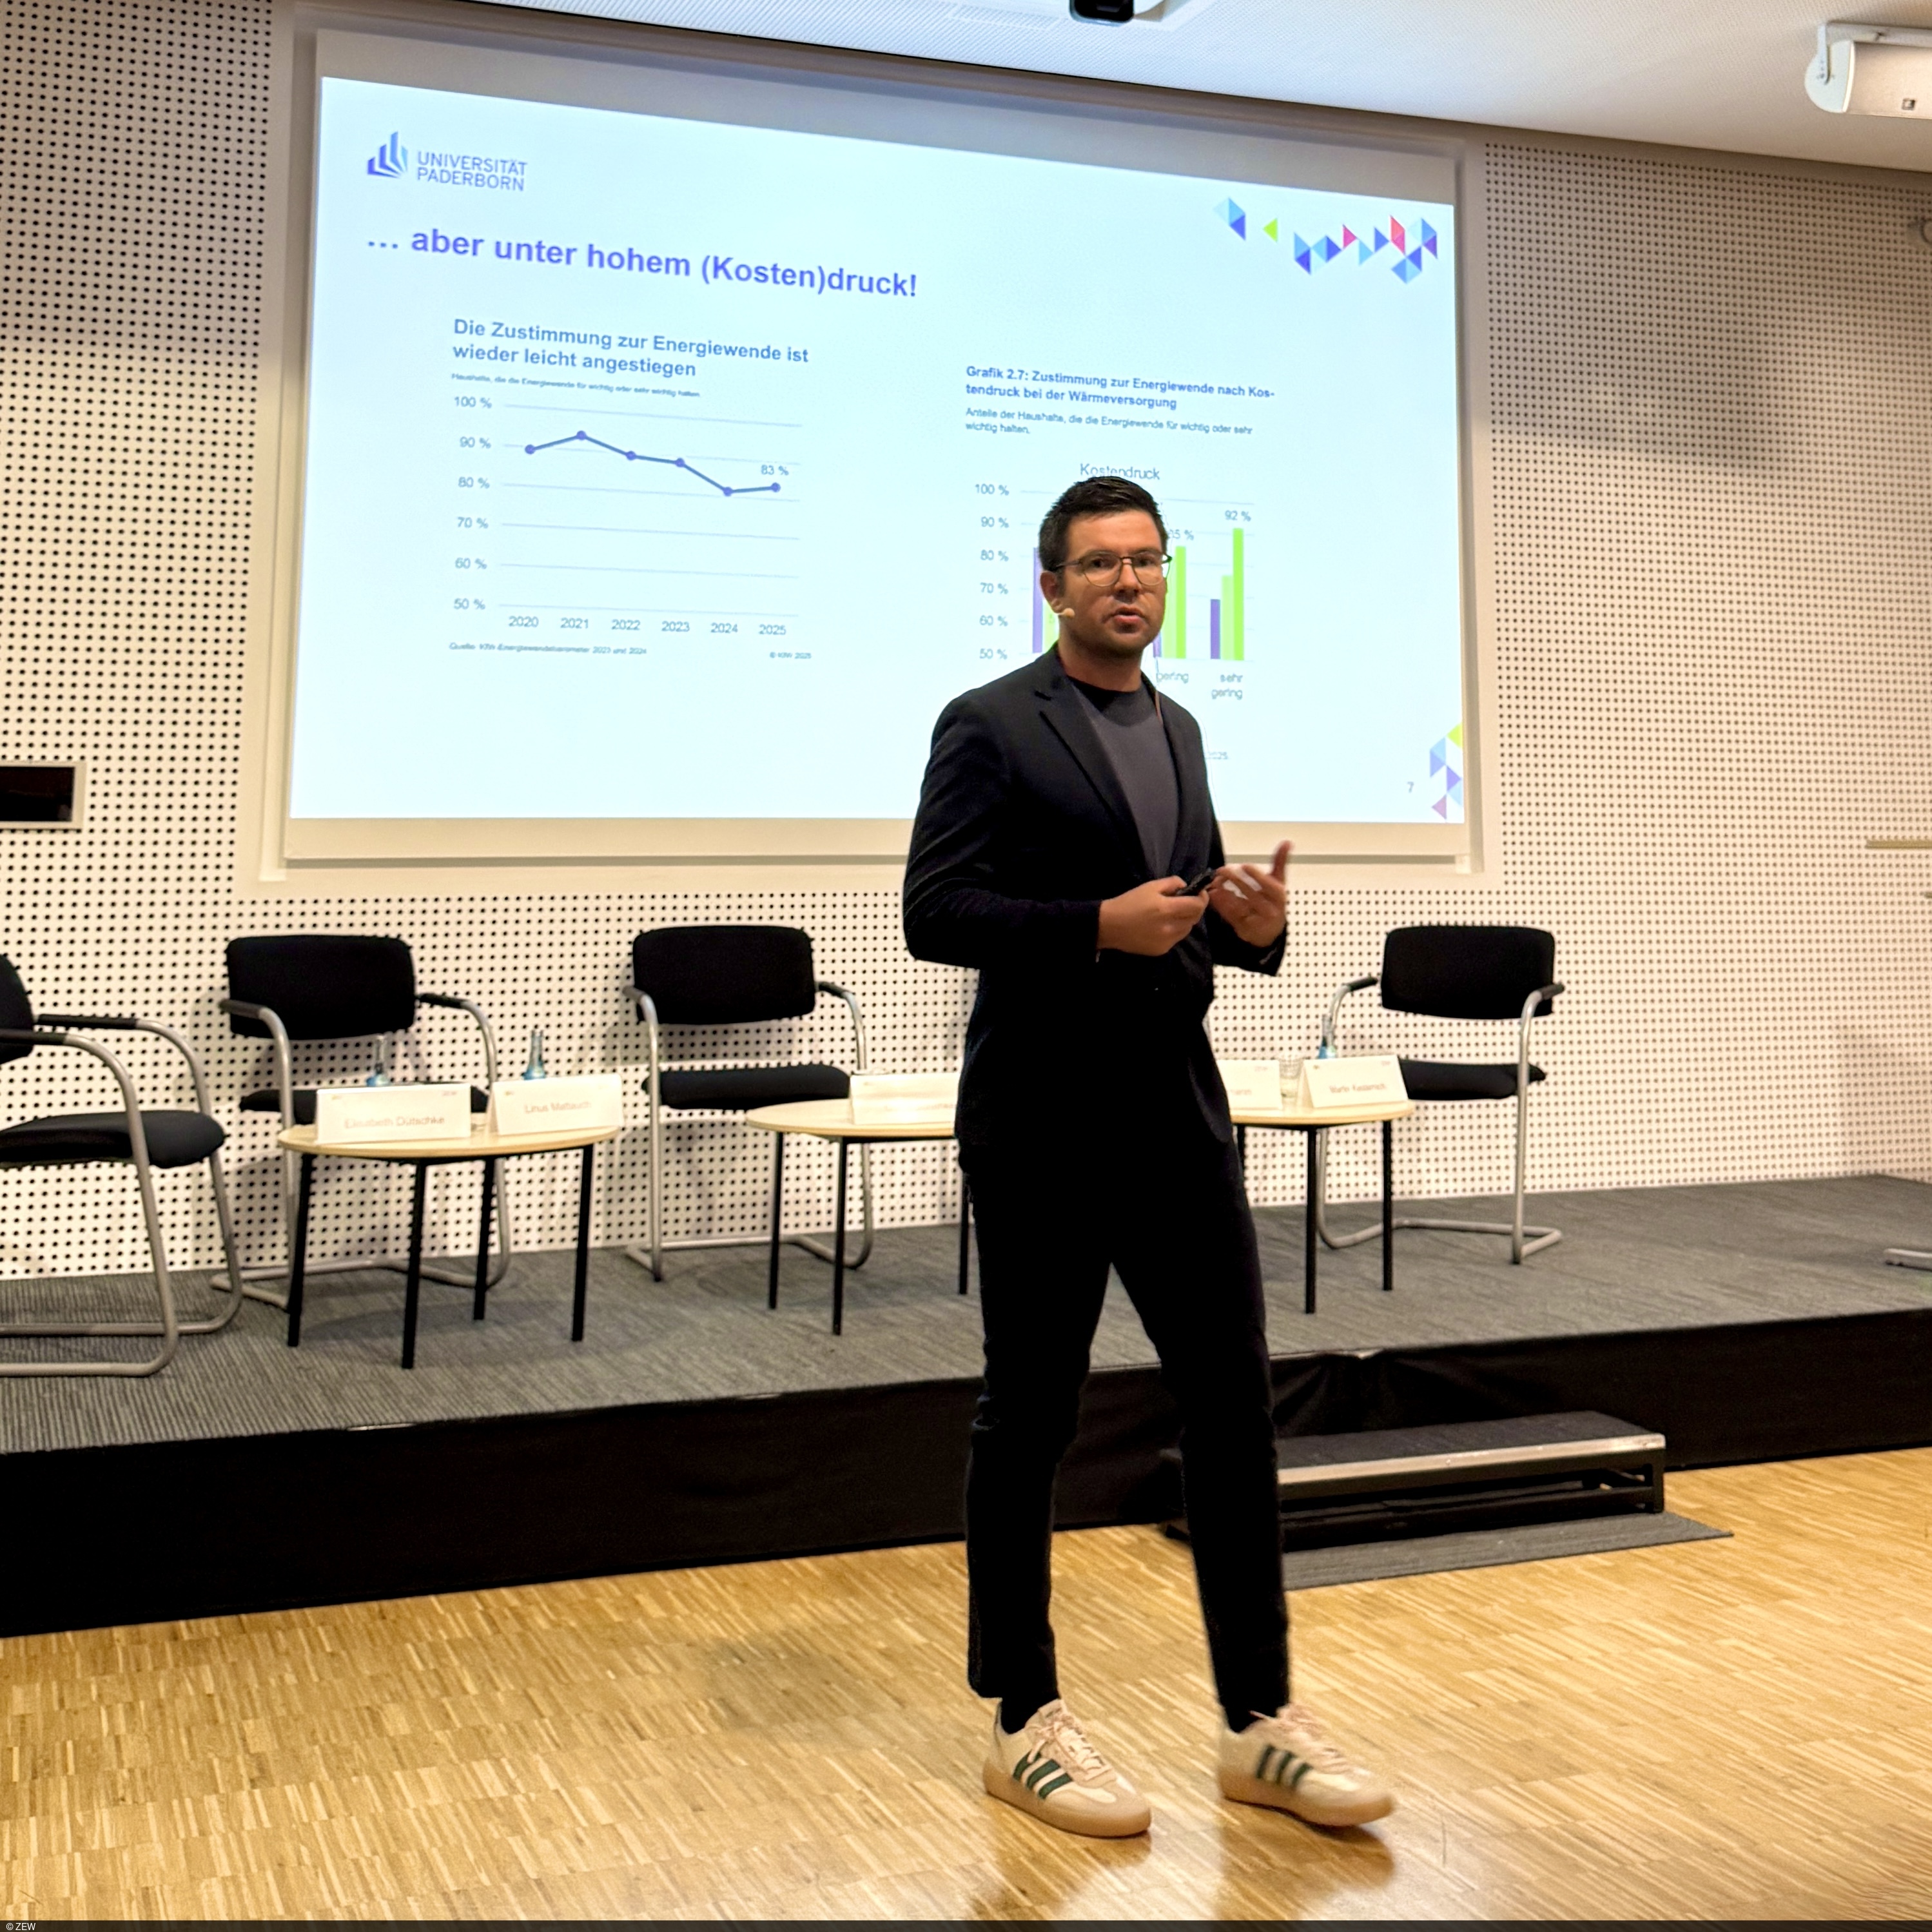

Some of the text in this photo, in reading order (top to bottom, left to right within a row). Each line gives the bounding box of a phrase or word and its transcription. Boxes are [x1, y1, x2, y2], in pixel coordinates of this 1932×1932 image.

[416, 150, 529, 177] UNIVERSITÄT
[416, 166, 525, 192] PADERBORN
[411, 228, 485, 257] aber
[494, 240, 578, 266] unter
[587, 244, 691, 277] hohem
[701, 255, 917, 297] (Kosten)druck!
[453, 318, 809, 363] Die Zustimmung zur Energiewende ist
[453, 343, 696, 378] wieder leicht angestiegen
[966, 365, 1275, 398] Grafik 2.7: Zustimmung zur Energiewende nach Kos-
[454, 396, 493, 409] 100 %
[966, 384, 1177, 410] tendruck bei der Wärmeversorgung
[965, 407, 1253, 435] Anteile der Haushalte, die die Energiewende für wichtig oder sehr
[965, 422, 997, 434] wichtig
[459, 436, 491, 449] 90 %
[761, 464, 790, 476] 83 %
[1079, 462, 1161, 480] Kostendruck
[458, 476, 490, 489] 80 %
[975, 483, 1010, 496] 100 %
[1224, 510, 1252, 522] 92 %
[456, 517, 489, 529] 70 %
[981, 517, 1010, 529] 90 %
[1184, 530, 1195, 541] %
[980, 551, 1010, 561] 80 %
[454, 558, 487, 570] 60 %
[980, 583, 1009, 594] 70 %
[453, 598, 485, 610] 50 %
[508, 616, 787, 636] 2020 2021 2022 2023 2024 2025
[979, 616, 1009, 627] 60 %
[979, 649, 1008, 660] 50 %
[1220, 672, 1244, 683] sehr
[1211, 687, 1244, 700] gering
[1407, 781, 1415, 794] 7
